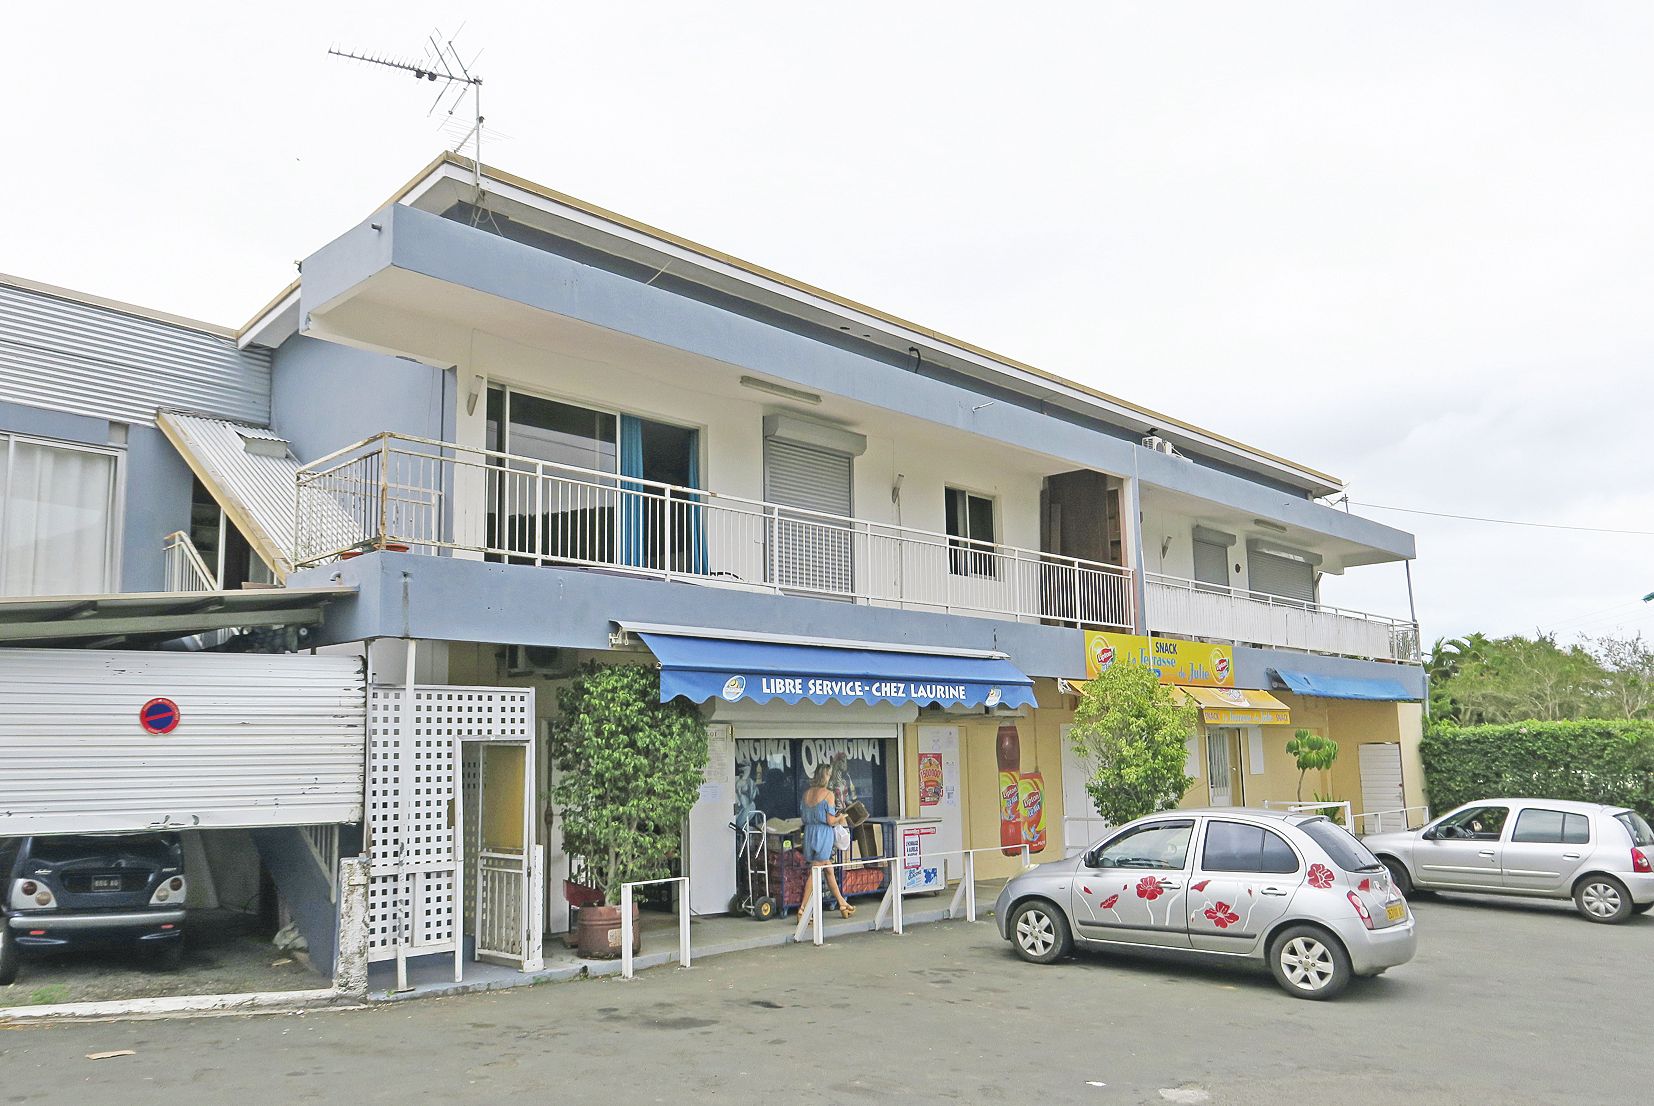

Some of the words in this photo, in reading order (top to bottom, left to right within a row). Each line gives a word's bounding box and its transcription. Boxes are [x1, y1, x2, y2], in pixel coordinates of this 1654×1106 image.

[1096, 649, 1112, 663] Lipton
[1155, 641, 1178, 655] SNACK
[1188, 662, 1210, 683] Julie
[761, 677, 803, 695] LIBRE
[910, 683, 967, 700] LAURINE
[801, 739, 880, 779] ORANGINA
[1001, 785, 1018, 799] Lipton
[1023, 792, 1041, 808] Lipton
